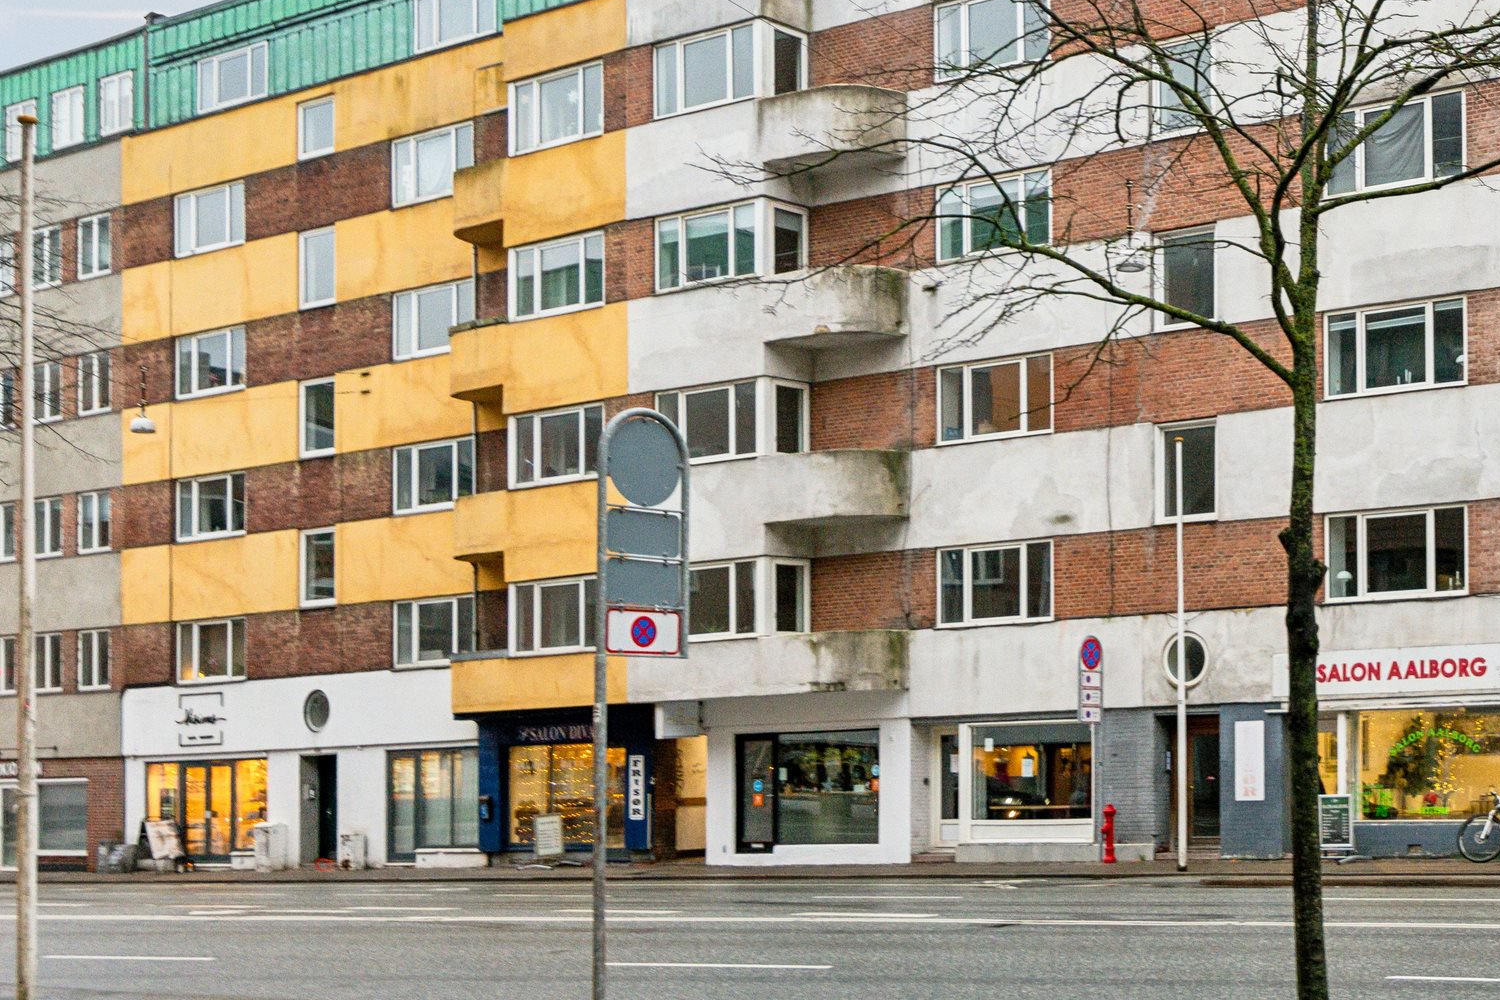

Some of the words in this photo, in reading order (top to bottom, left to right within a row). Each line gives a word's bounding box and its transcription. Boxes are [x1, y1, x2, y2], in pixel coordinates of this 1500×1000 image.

[1316, 662, 1381, 683] SALON
[1387, 657, 1487, 680] AALBORG
[1389, 730, 1424, 757] SALON
[1428, 728, 1481, 753] AALBORG
